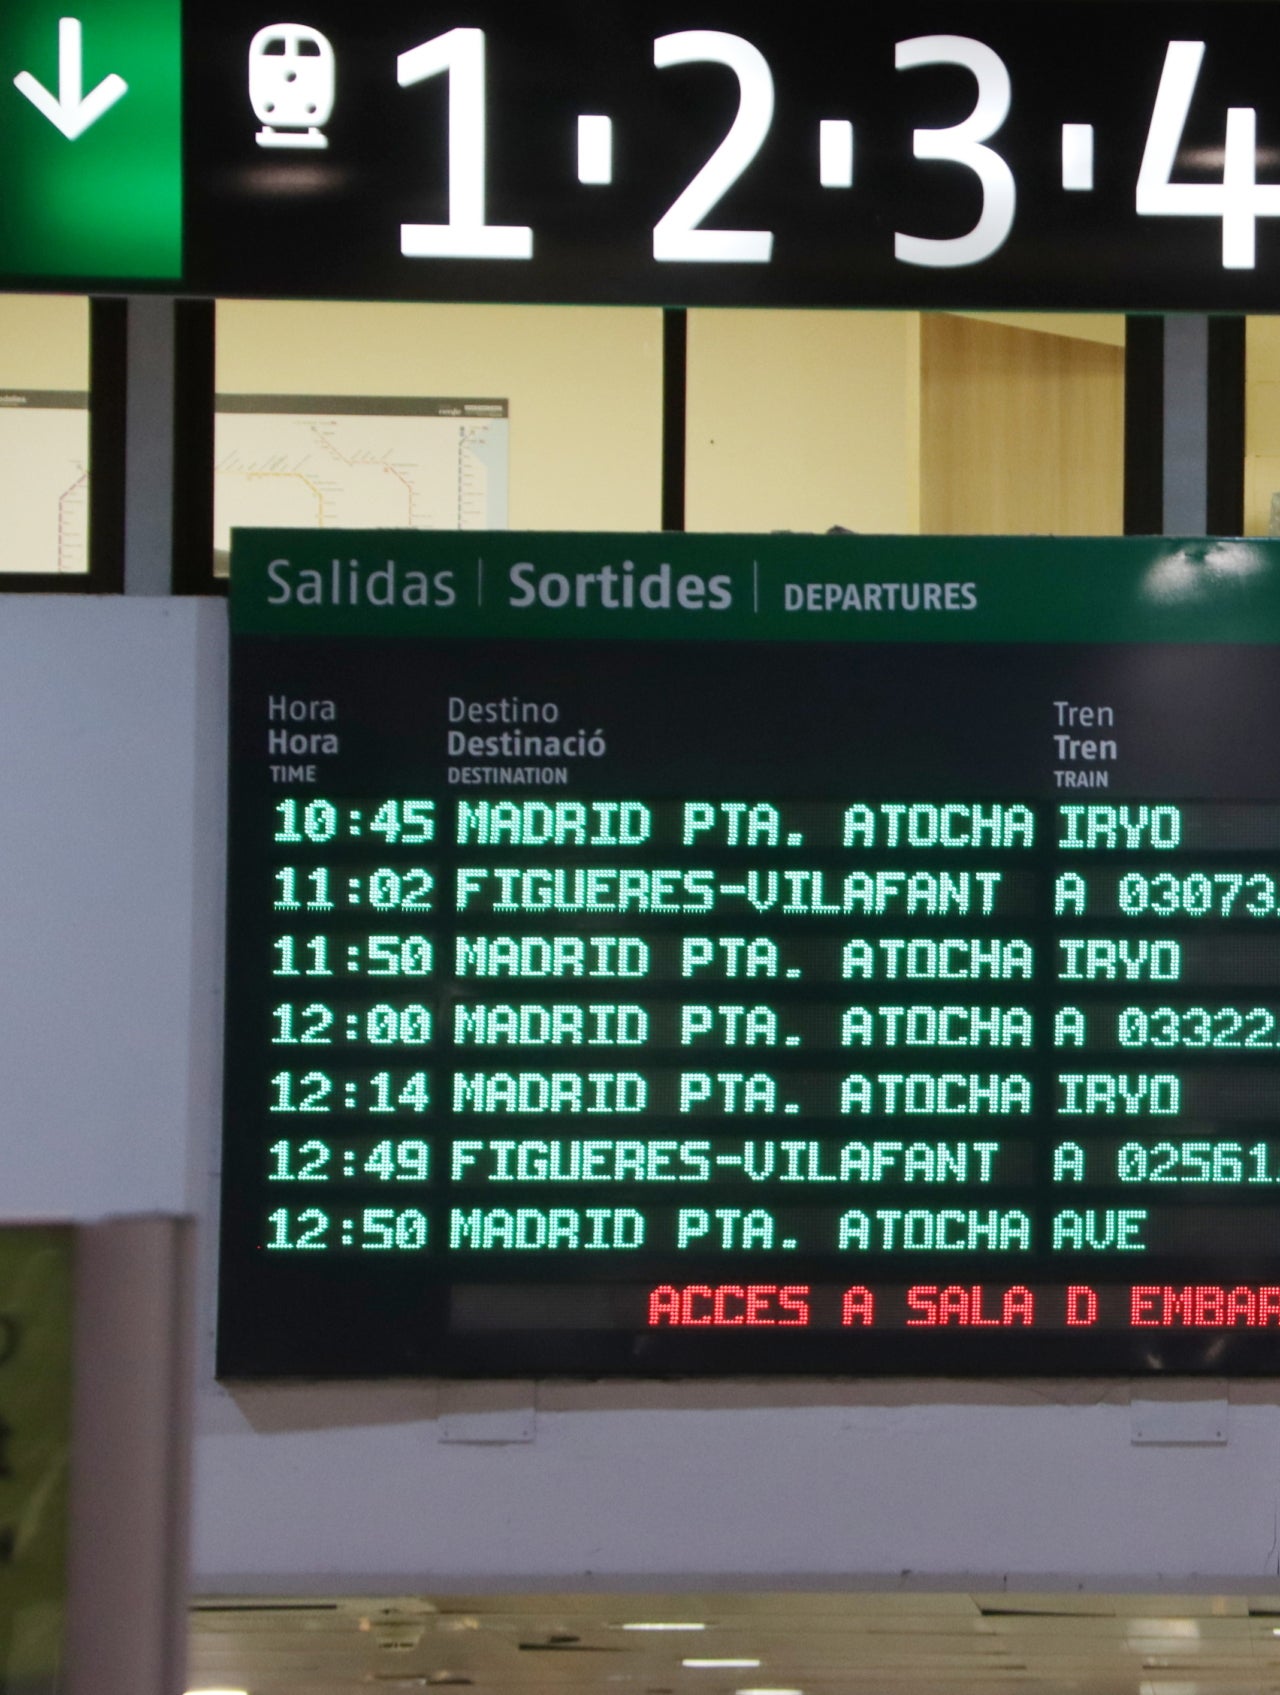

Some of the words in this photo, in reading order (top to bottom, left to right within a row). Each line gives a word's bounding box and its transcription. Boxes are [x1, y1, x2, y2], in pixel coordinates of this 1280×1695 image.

[268, 559, 455, 606] Salidas
[510, 561, 732, 609] Sortides
[785, 583, 977, 610] DEPARTURES
[269, 696, 335, 720] Hora
[449, 697, 558, 723] Destino
[1054, 702, 1113, 726] Tren
[269, 729, 338, 754] Hora
[448, 729, 605, 756] Destinació
[1054, 735, 1117, 760] Tren
[270, 765, 315, 782] TIME
[448, 767, 567, 784] DESTINATION
[1054, 771, 1108, 787] TRAIN
[275, 799, 434, 843] 10:45
[457, 801, 651, 845] MADRID
[683, 803, 803, 846] PTA.
[843, 804, 1034, 847] ATOCHA
[1059, 805, 1180, 849] IRYO
[274, 867, 434, 912] 11:02
[456, 869, 1001, 915] FIGUERES-VILAFANT
[1055, 872, 1085, 915] A
[273, 936, 433, 975] 11:50
[455, 937, 649, 977] MADRID
[682, 938, 801, 978] PTA.
[842, 939, 1032, 979] ATOCHA
[1058, 940, 1180, 980] IRYO
[272, 1004, 432, 1044] 12:00
[454, 1005, 648, 1045] MADRID
[681, 1005, 800, 1046] PTA.
[841, 1006, 1032, 1046] ATOCHA
[1054, 1007, 1085, 1046] A
[270, 1072, 429, 1112] 12:14
[453, 1073, 647, 1112] MADRID
[680, 1073, 799, 1114] PTA.
[841, 1074, 1031, 1114] ATOCHA
[1058, 1074, 1180, 1114] IRYO
[269, 1140, 429, 1180] 12:49
[451, 1140, 998, 1182] FIGUERES-VILAFANT
[1053, 1142, 1084, 1181] A
[267, 1208, 427, 1249] 12:50
[450, 1208, 645, 1249] MADRID
[678, 1209, 796, 1249] PTA.
[839, 1210, 1030, 1250] ATOCHA
[1053, 1210, 1147, 1250] AVE
[648, 1285, 809, 1326] ACCES
[842, 1286, 874, 1326] A
[907, 1286, 1034, 1326] SALA
[1067, 1286, 1098, 1325] D
